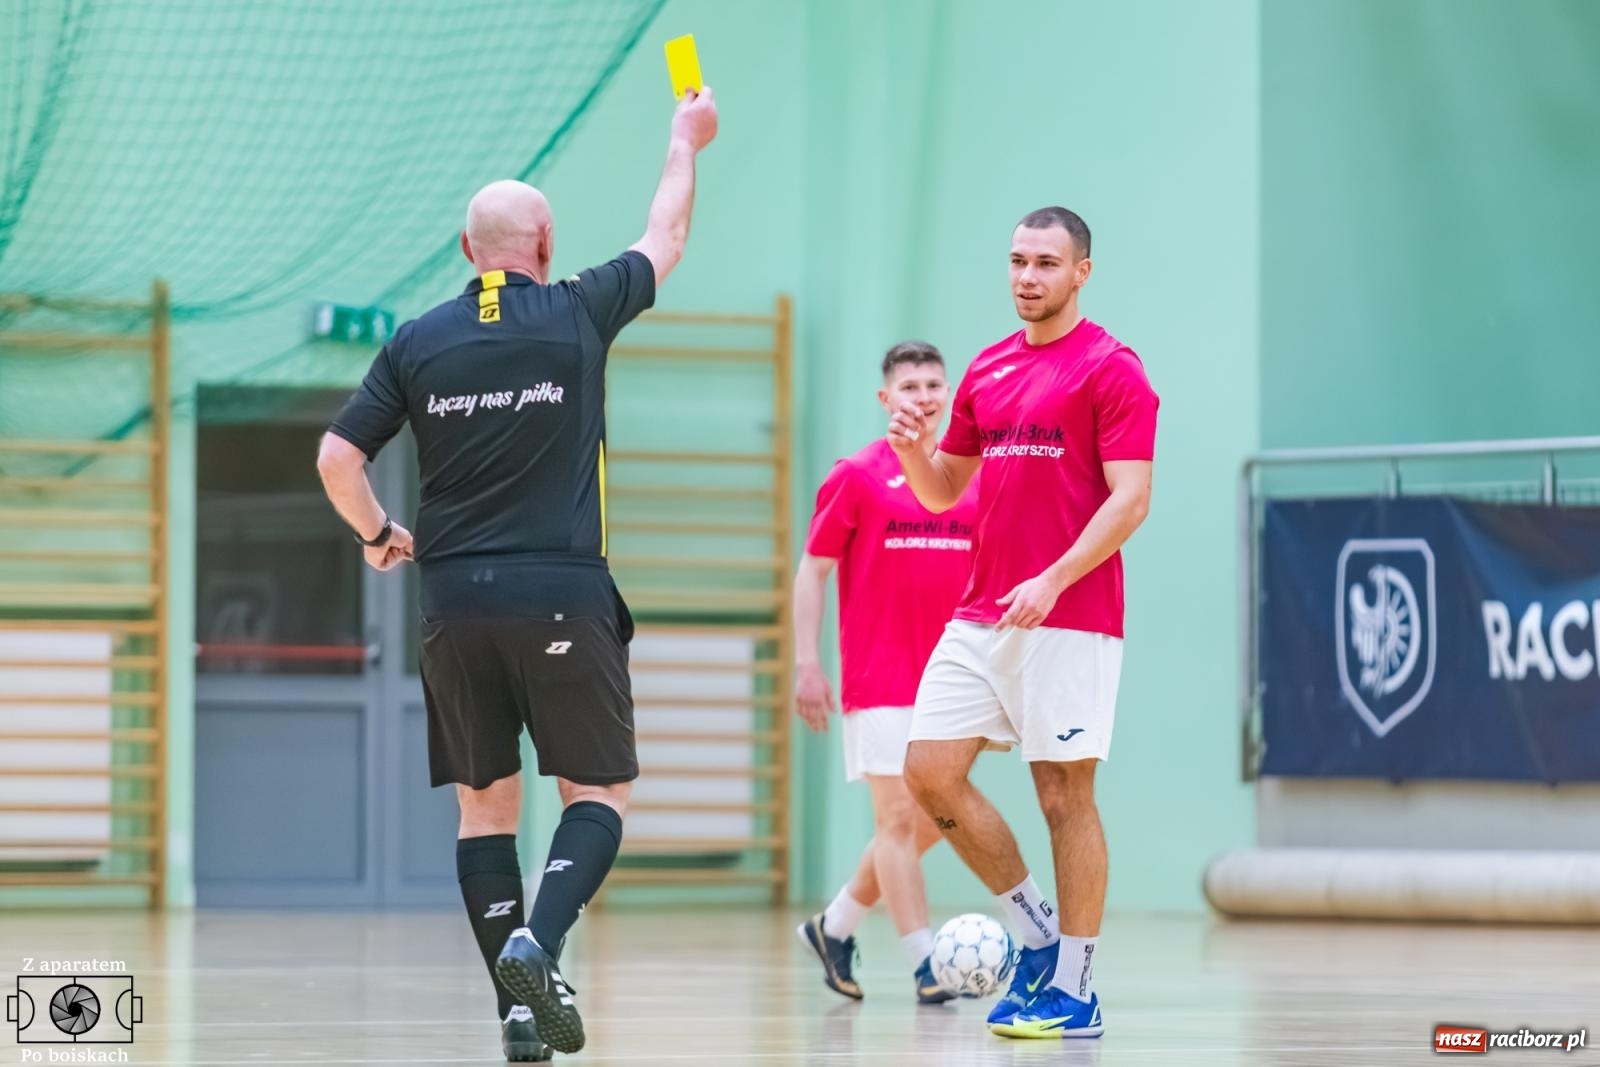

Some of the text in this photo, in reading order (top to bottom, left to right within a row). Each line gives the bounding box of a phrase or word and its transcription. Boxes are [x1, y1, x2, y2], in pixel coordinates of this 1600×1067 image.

[427, 381, 565, 417] Łączy nas piłka
